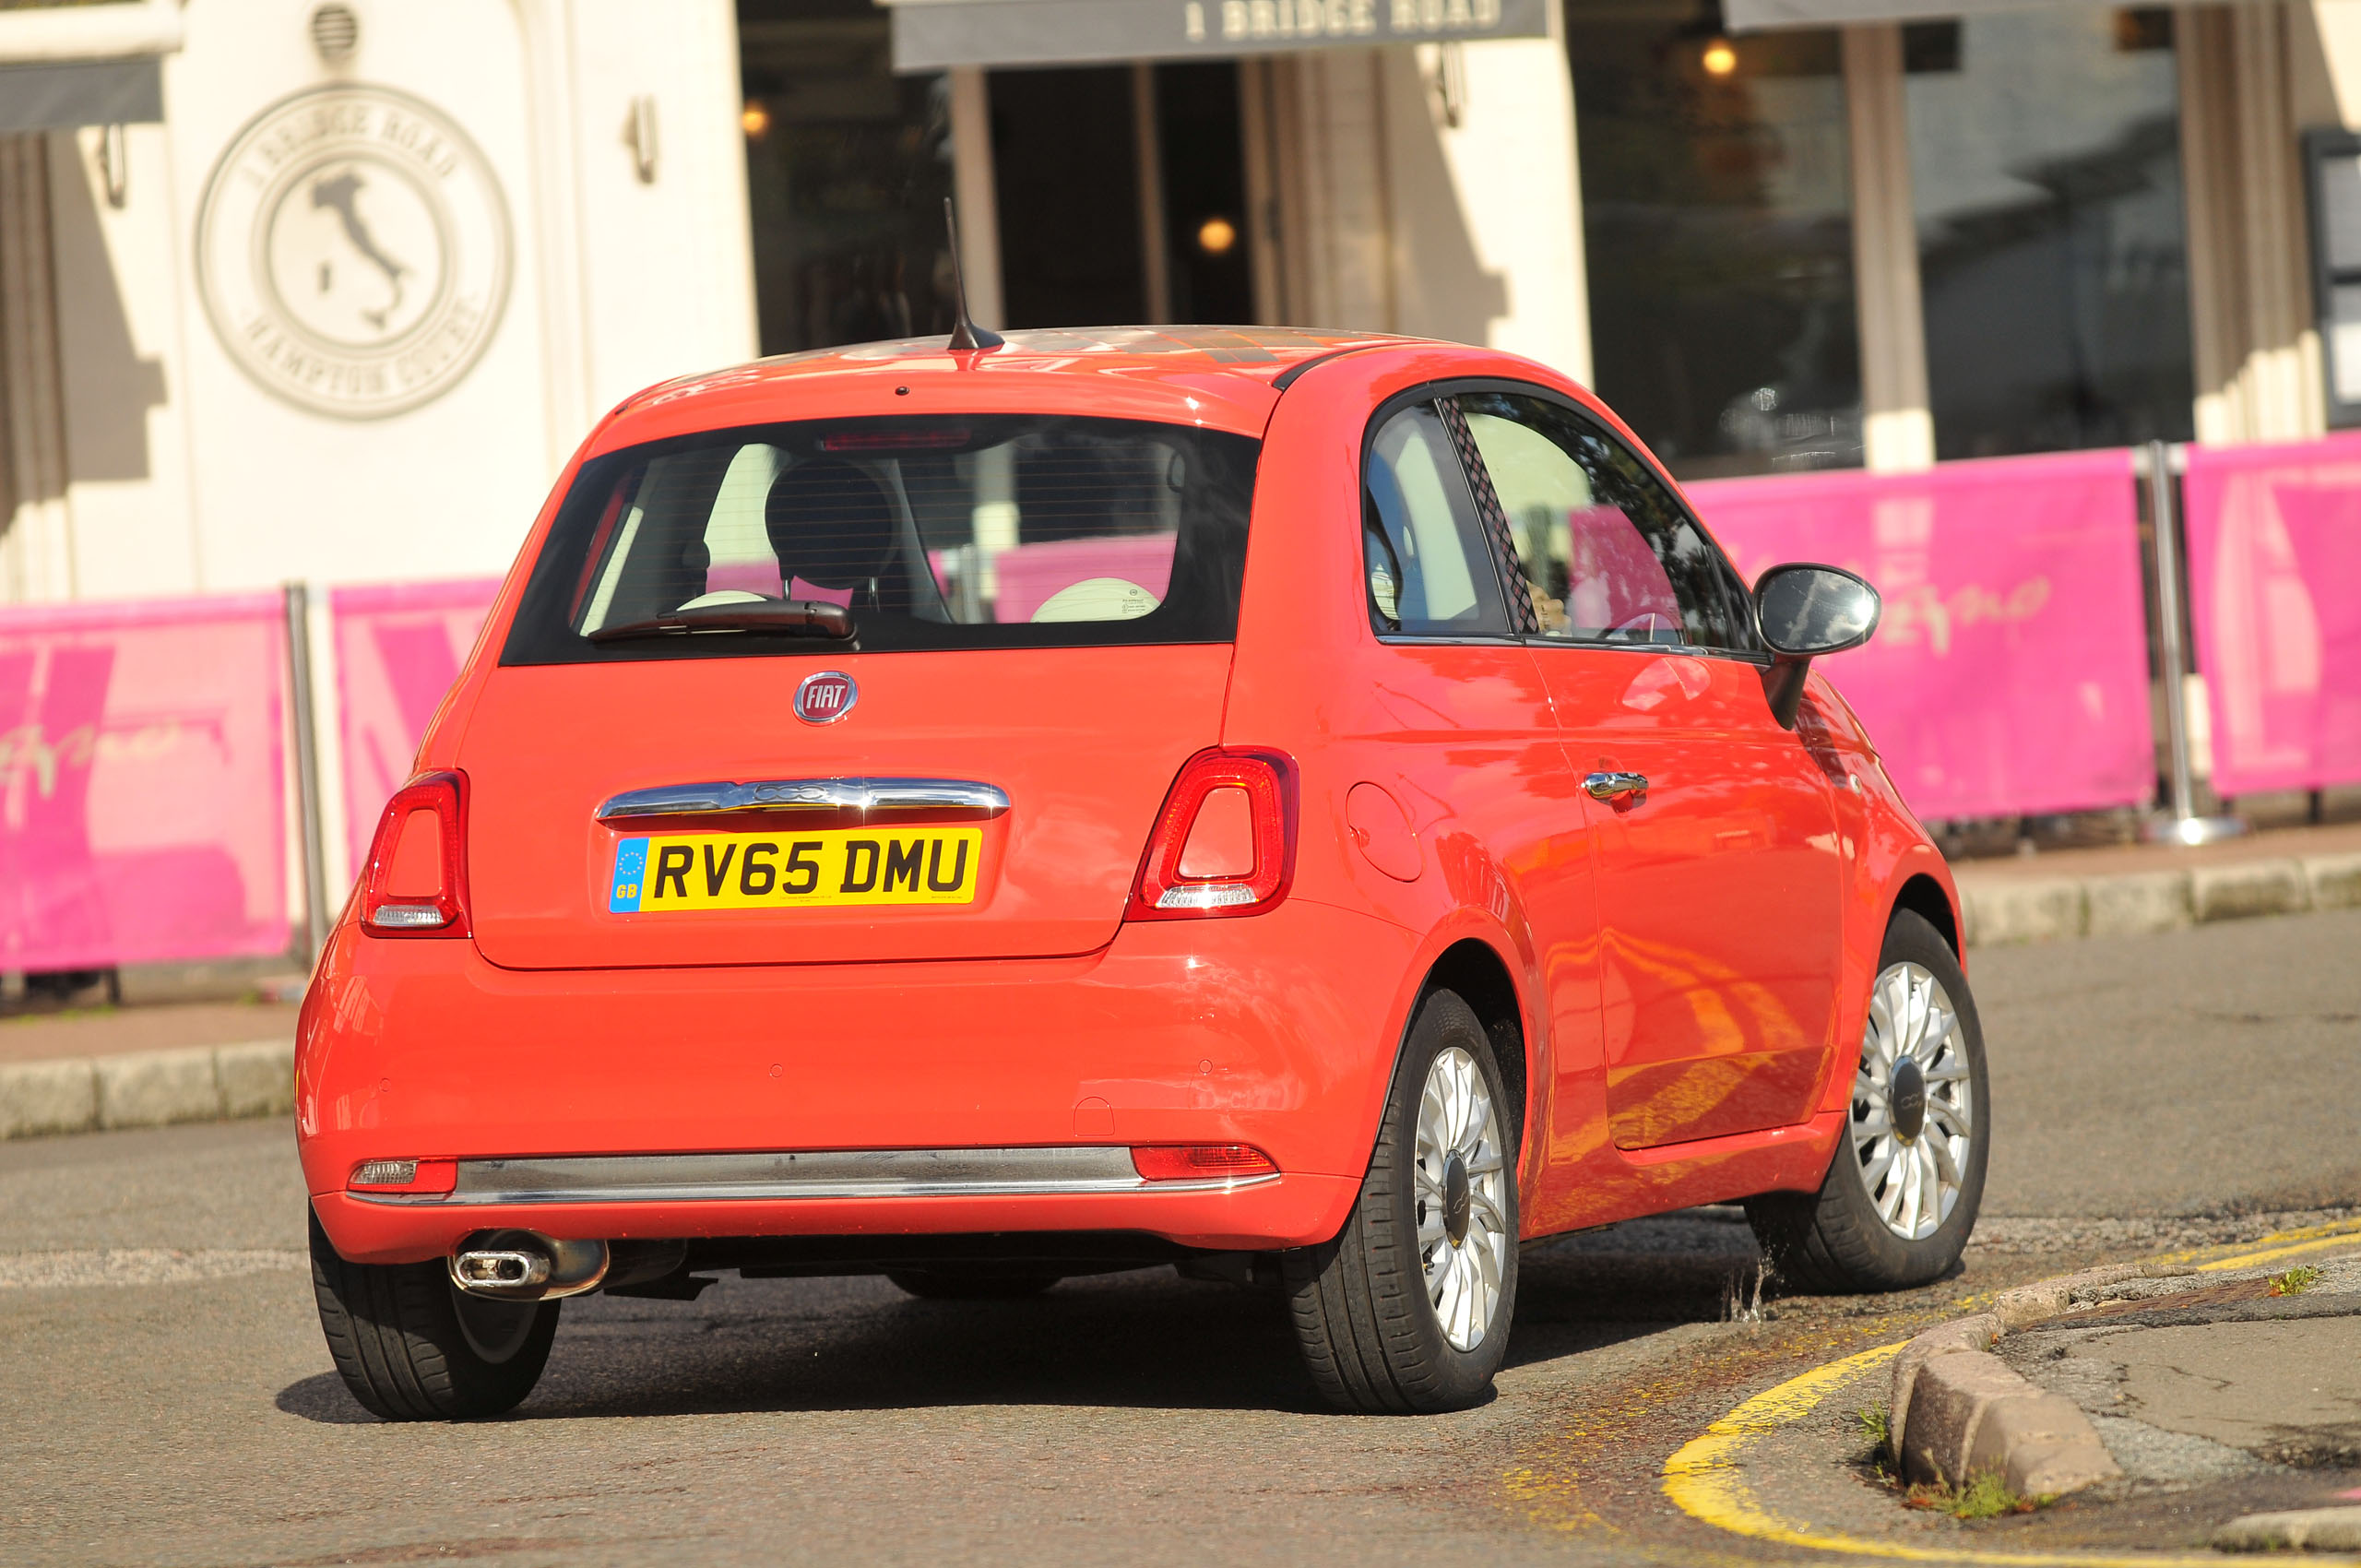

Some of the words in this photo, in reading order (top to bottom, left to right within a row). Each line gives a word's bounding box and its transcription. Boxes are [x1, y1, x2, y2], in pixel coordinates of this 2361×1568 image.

[1185, 0, 1205, 42] 1
[1222, 0, 1376, 40] BRIDGE
[1390, 0, 1501, 32] ROAD
[806, 684, 846, 709] FIAT
[654, 840, 824, 898] RV65
[839, 838, 968, 894] DMU
[616, 884, 638, 899] GB
